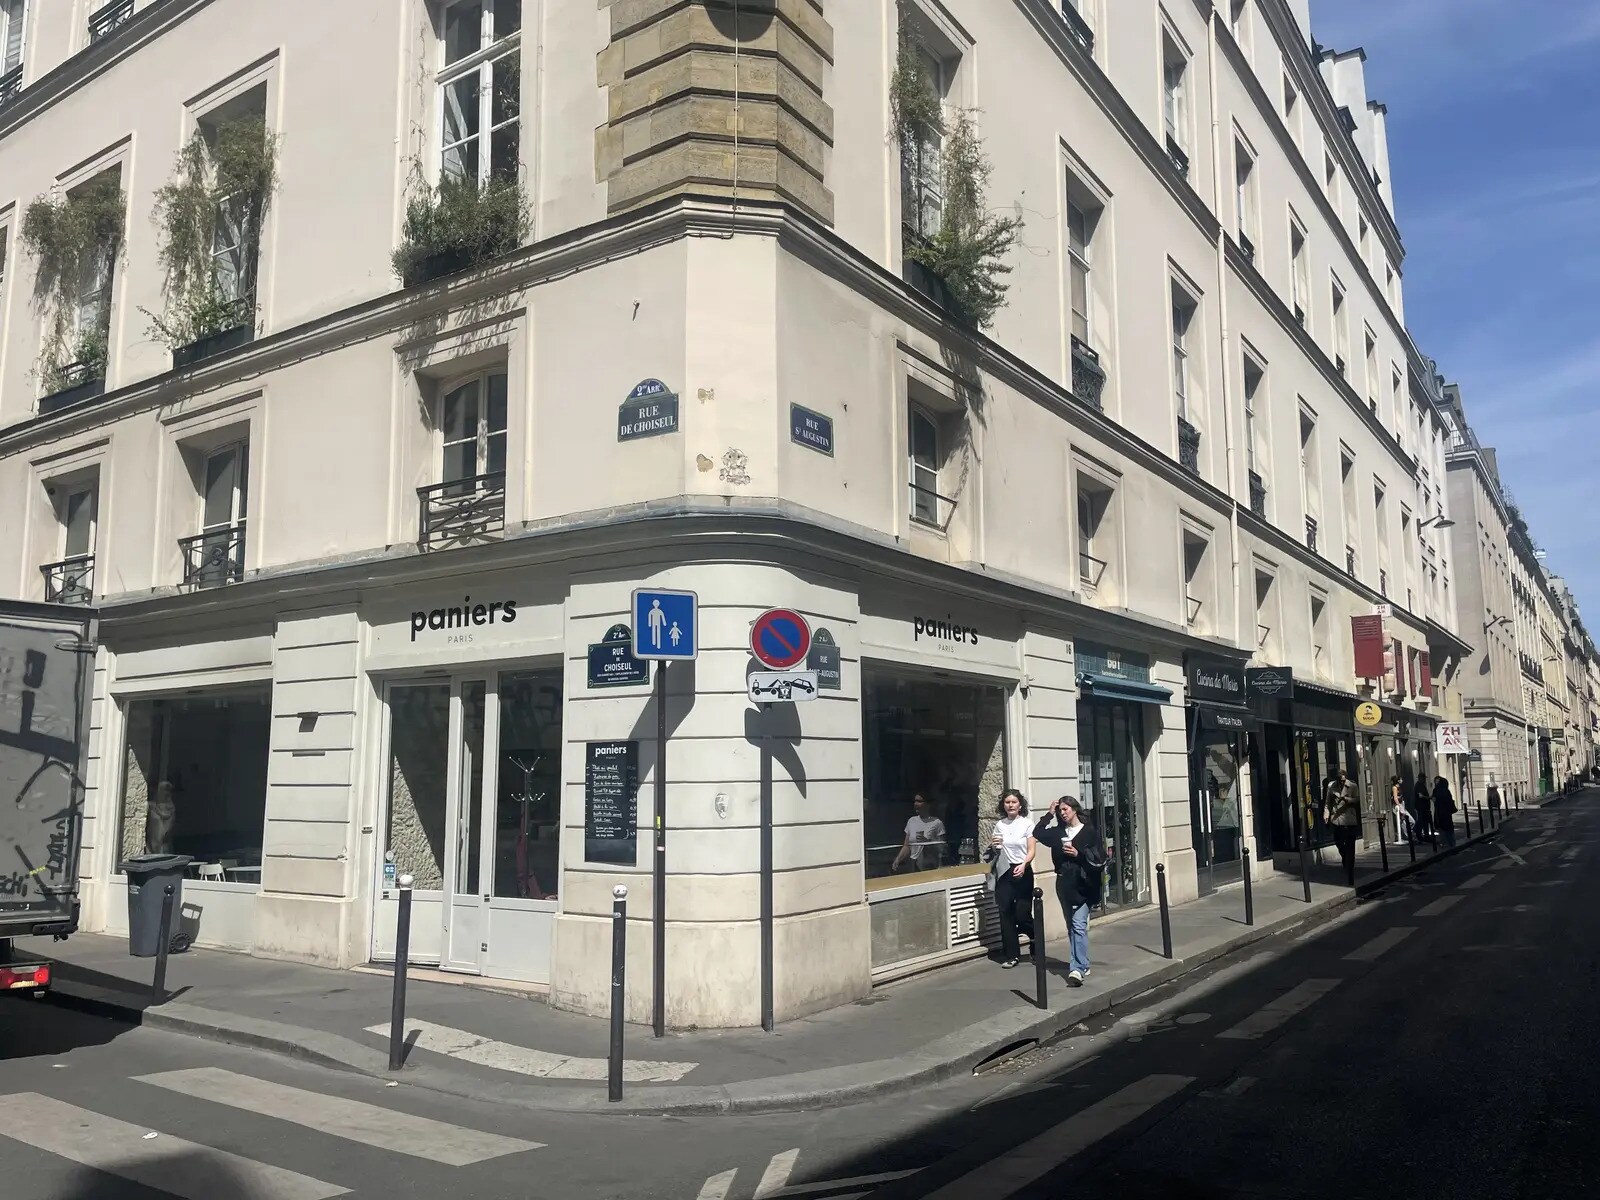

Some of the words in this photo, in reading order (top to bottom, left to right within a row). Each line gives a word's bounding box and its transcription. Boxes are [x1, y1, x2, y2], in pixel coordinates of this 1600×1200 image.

[639, 405, 660, 419] RUE
[621, 424, 633, 435] DE
[633, 415, 676, 433] CHOISEUL
[806, 418, 819, 431] RUE
[802, 429, 830, 447] AUGUSTIN
[410, 595, 517, 642] paniers
[914, 613, 979, 646] paniers
[447, 634, 474, 644] PARIS
[612, 647, 625, 656] RUE
[938, 643, 955, 653] PARIS
[603, 662, 633, 672] CHOISEUL
[1196, 668, 1215, 688] Cucina
[1214, 672, 1222, 689] da
[1221, 673, 1239, 693] Mario
[1442, 726, 1461, 736] ZH
[595, 743, 627, 758] paniers
